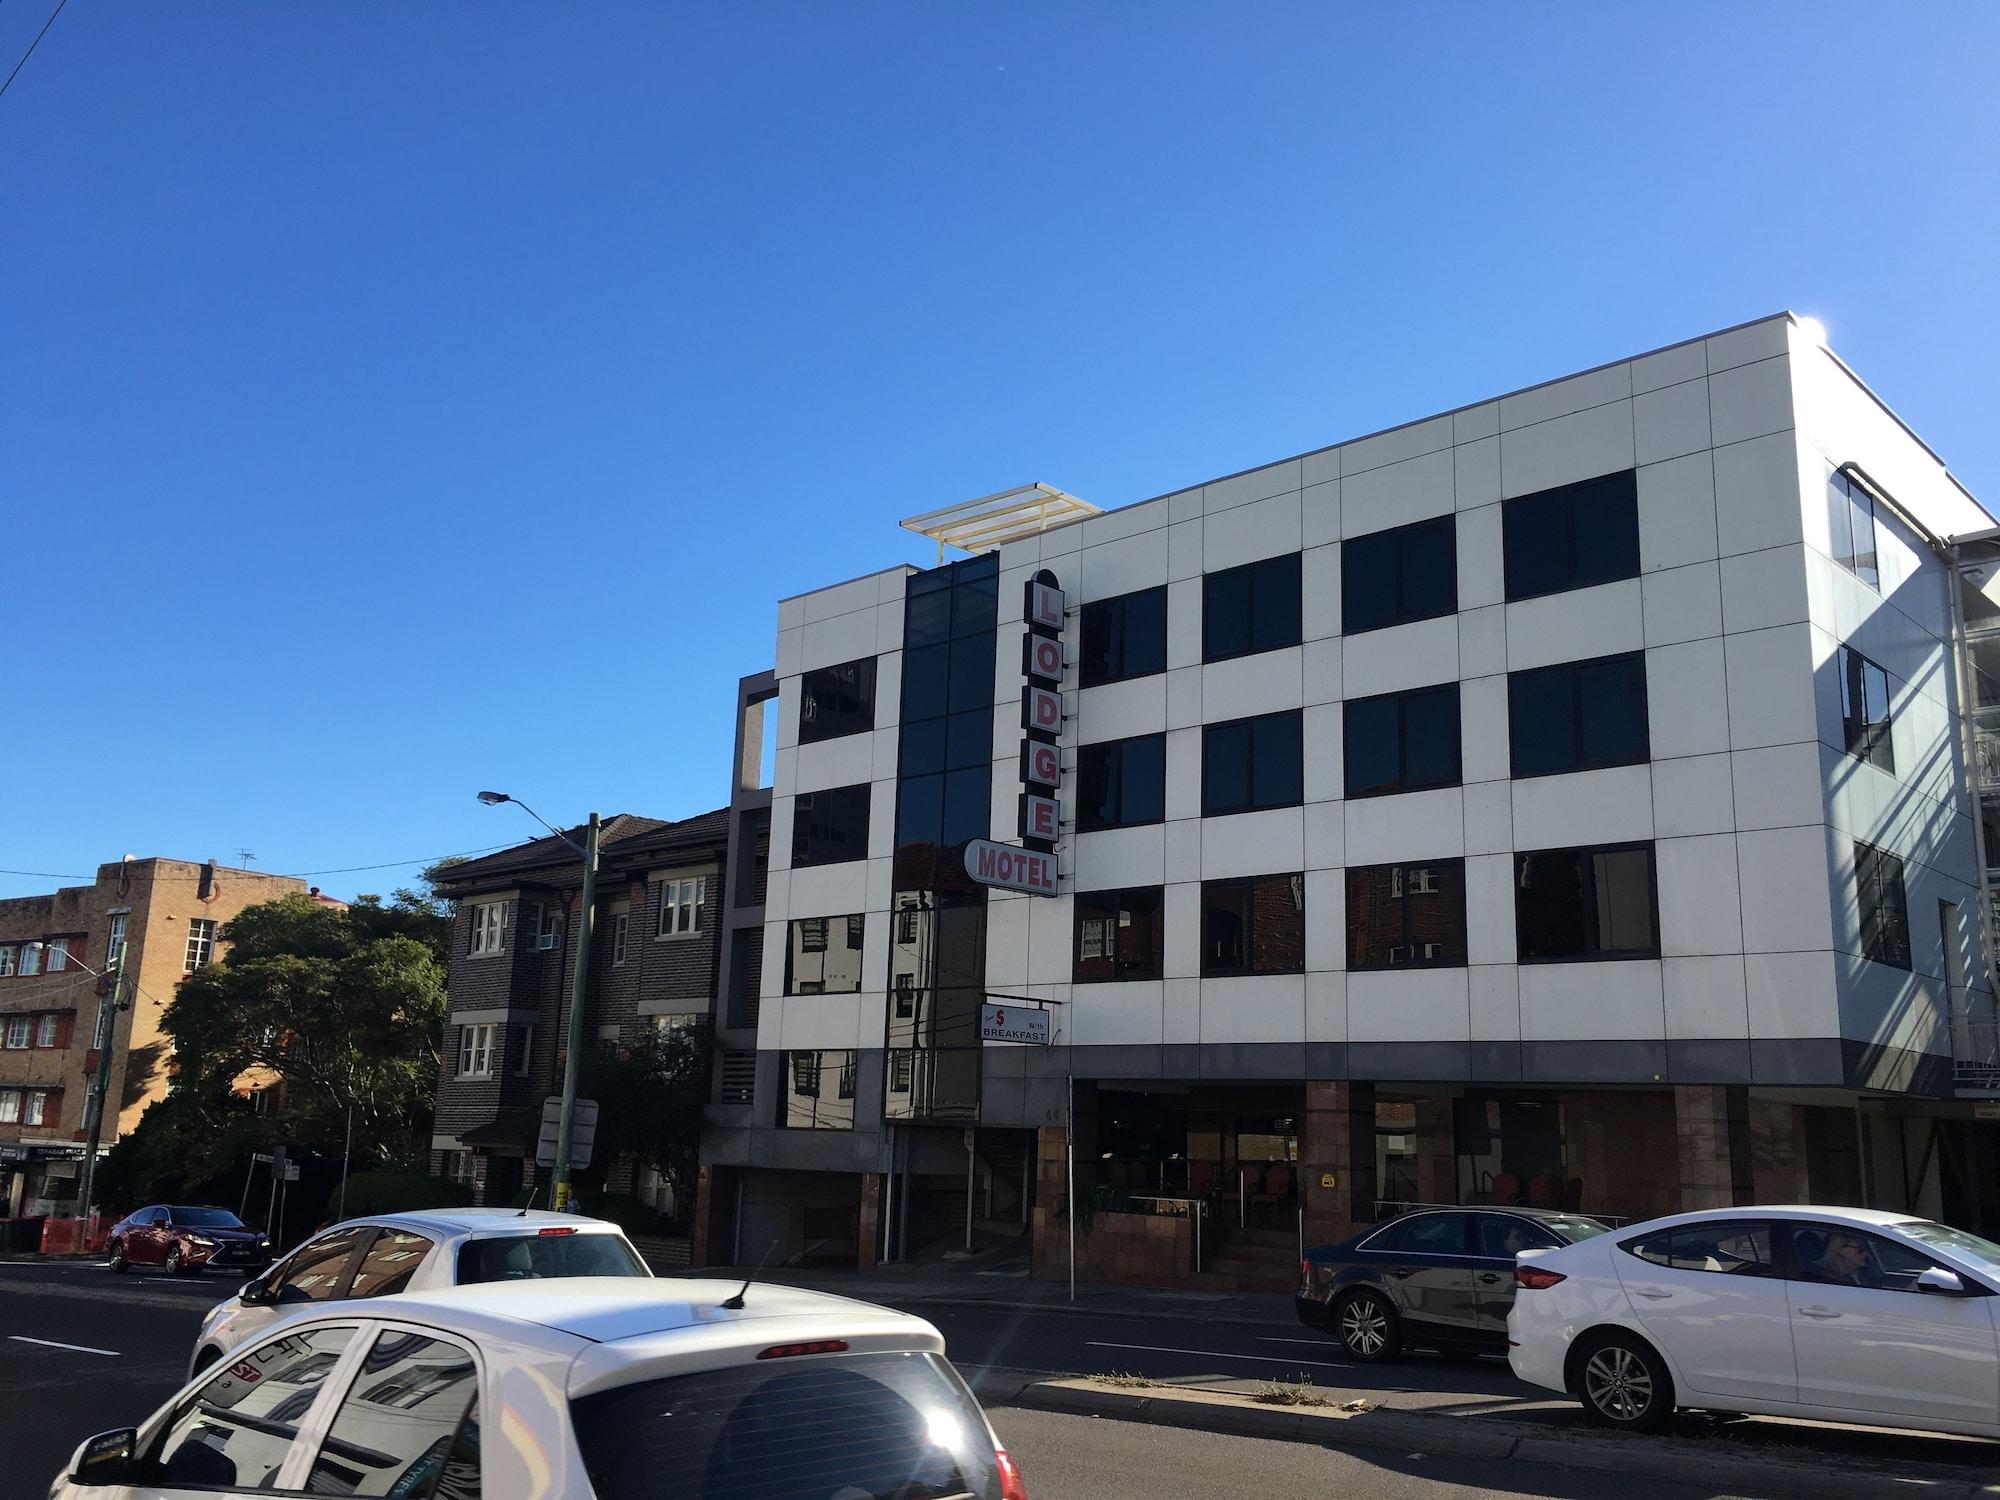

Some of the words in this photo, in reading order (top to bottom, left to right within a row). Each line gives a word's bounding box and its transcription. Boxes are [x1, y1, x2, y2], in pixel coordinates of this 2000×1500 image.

[1035, 591, 1058, 833] LODGE
[978, 846, 1052, 888] MOTEL
[983, 1028, 1046, 1041] BREAKFAST
